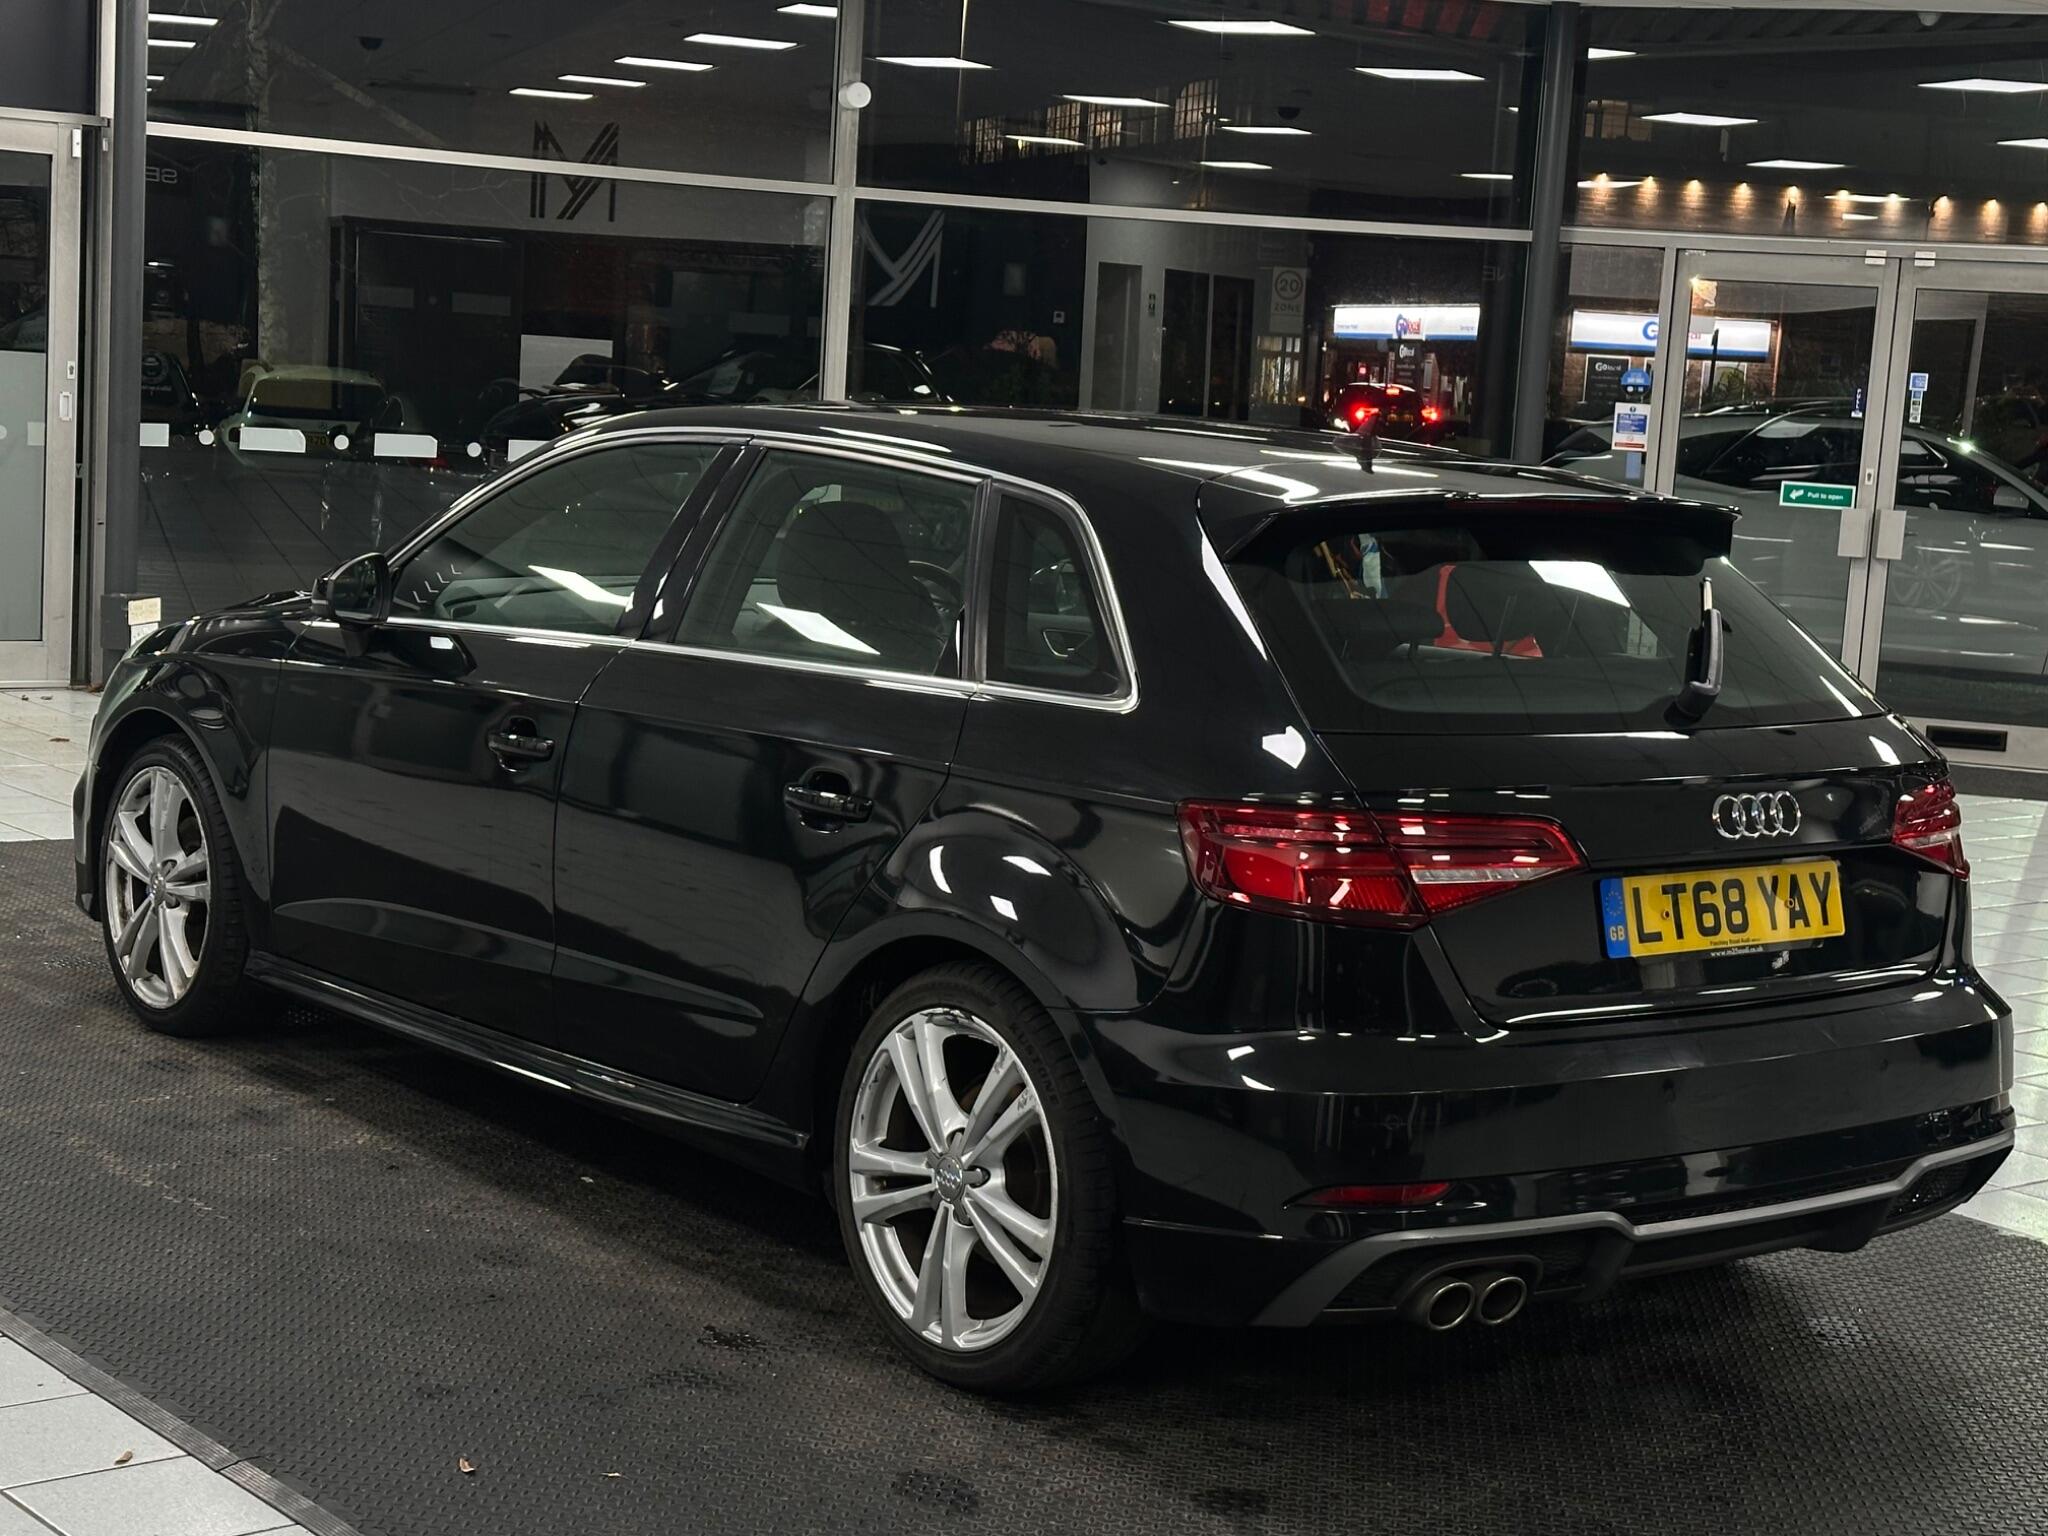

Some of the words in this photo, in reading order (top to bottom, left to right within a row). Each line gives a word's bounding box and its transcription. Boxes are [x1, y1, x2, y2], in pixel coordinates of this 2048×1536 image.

[1279, 278, 1300, 292] 20
[1273, 302, 1302, 312] ZONE
[1807, 491, 1819, 499] Pull
[1632, 878, 1749, 944] LT68
[1757, 871, 1832, 931] YAY
[1609, 924, 1625, 942] GB
